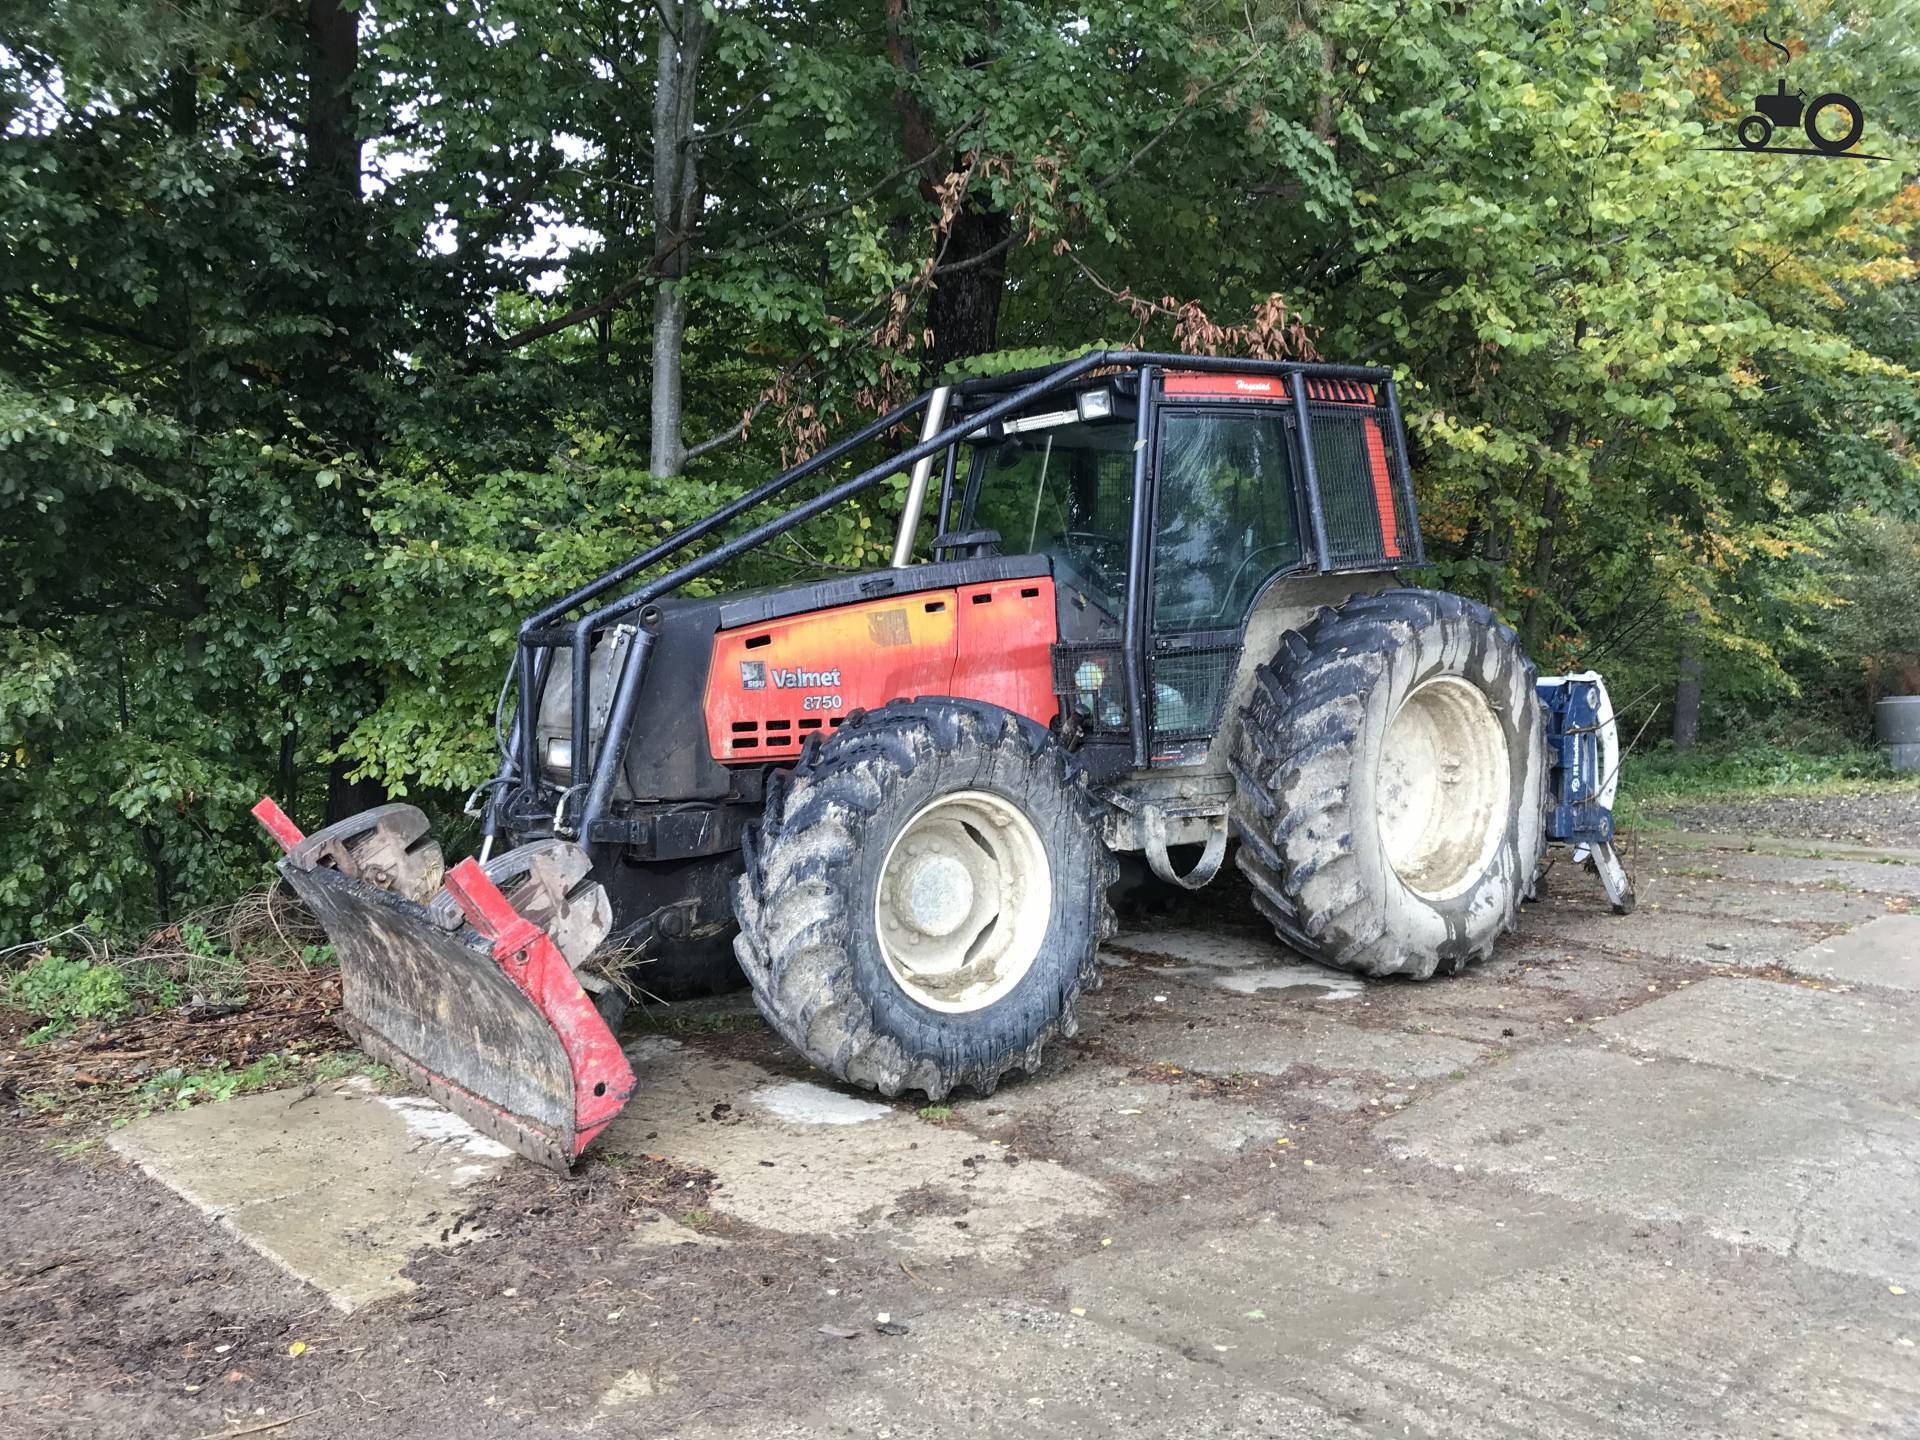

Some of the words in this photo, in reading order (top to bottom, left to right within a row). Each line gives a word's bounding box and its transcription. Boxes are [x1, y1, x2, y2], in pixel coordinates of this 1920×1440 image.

[747, 680, 765, 688] SISU
[770, 667, 841, 689] Valmet
[803, 695, 842, 710] 8750
